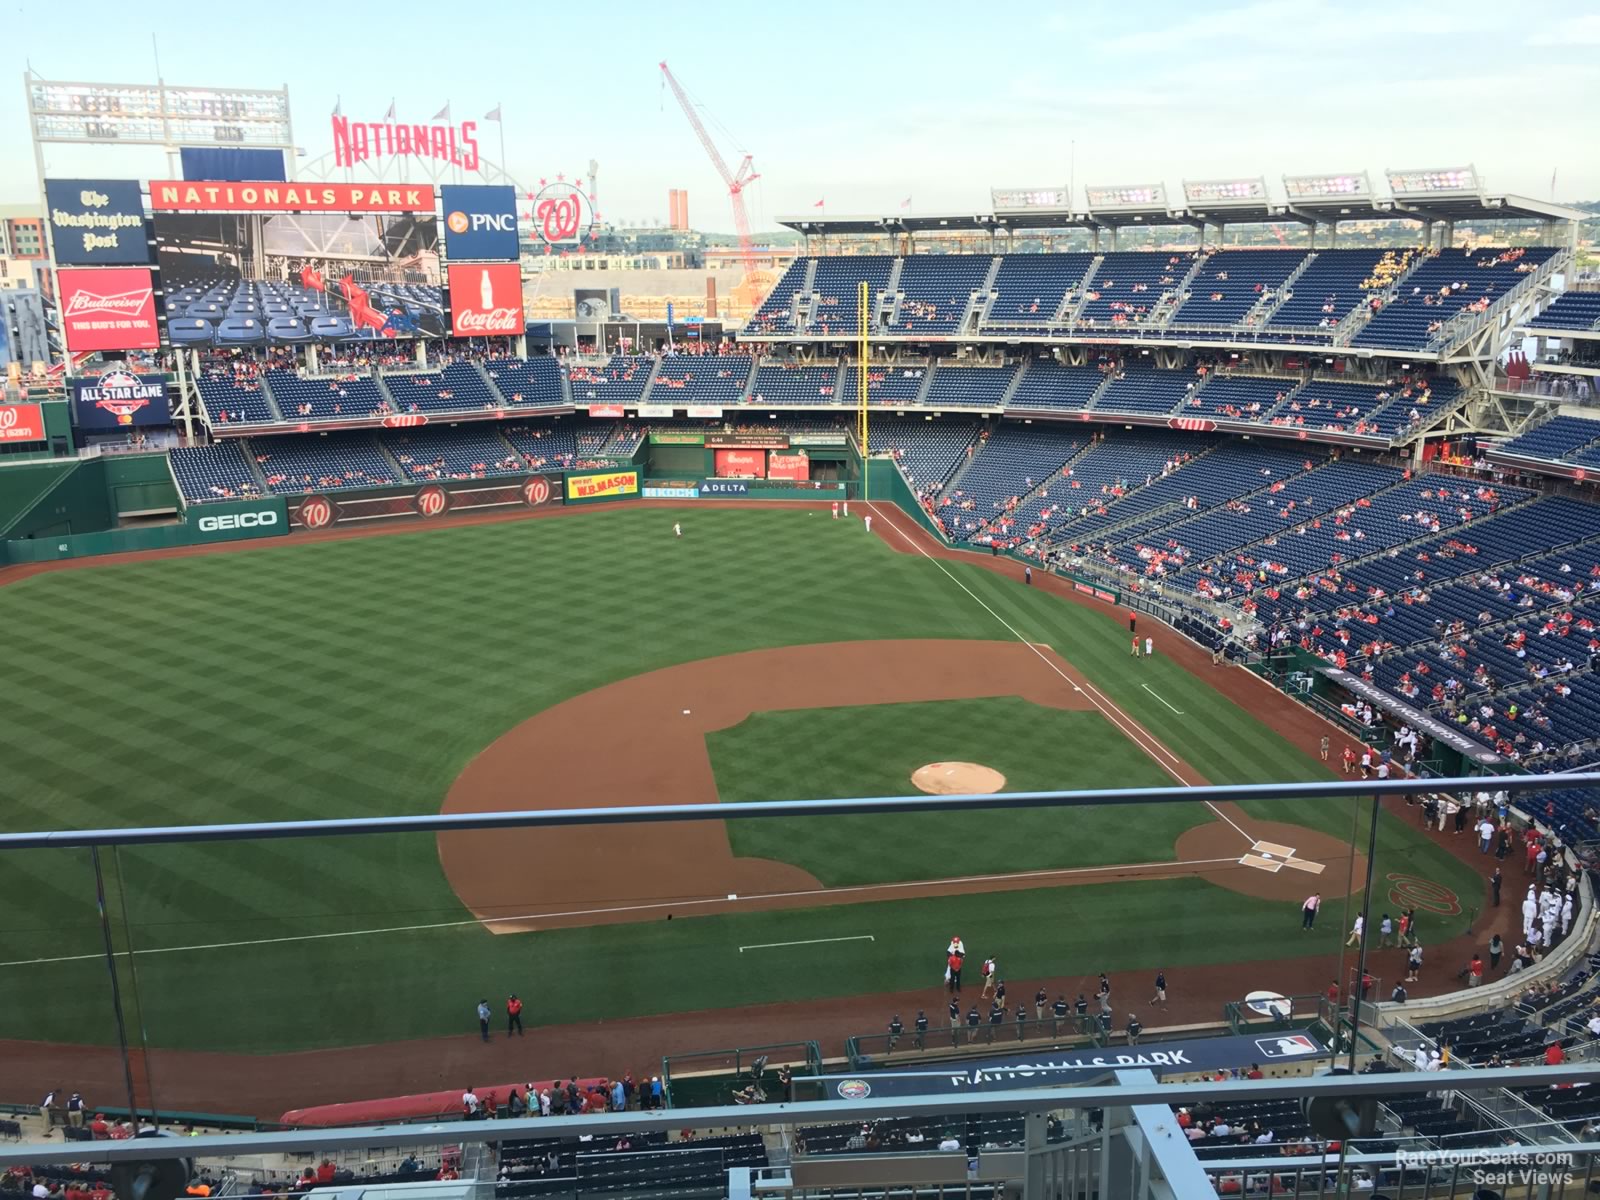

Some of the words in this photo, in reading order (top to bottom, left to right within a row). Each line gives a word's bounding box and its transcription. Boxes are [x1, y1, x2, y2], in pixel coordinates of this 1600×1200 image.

[331, 113, 479, 170] NATIONALS
[80, 190, 110, 206] The
[161, 186, 336, 205] NATIONALS
[351, 190, 421, 206] PARK
[53, 208, 143, 231] Washington
[471, 213, 515, 232] PNC
[83, 233, 119, 252] Post
[70, 294, 144, 309] Budweiser
[72, 321, 91, 330] THIS
[116, 320, 132, 329] FOR
[456, 308, 520, 331] Coca-Cola
[133, 386, 163, 398] GAME
[712, 484, 746, 492] DELTA
[198, 510, 278, 532] GEICO
[1343, 677, 1398, 709] NATIONALS
[1397, 706, 1475, 749] WASHINGTON
